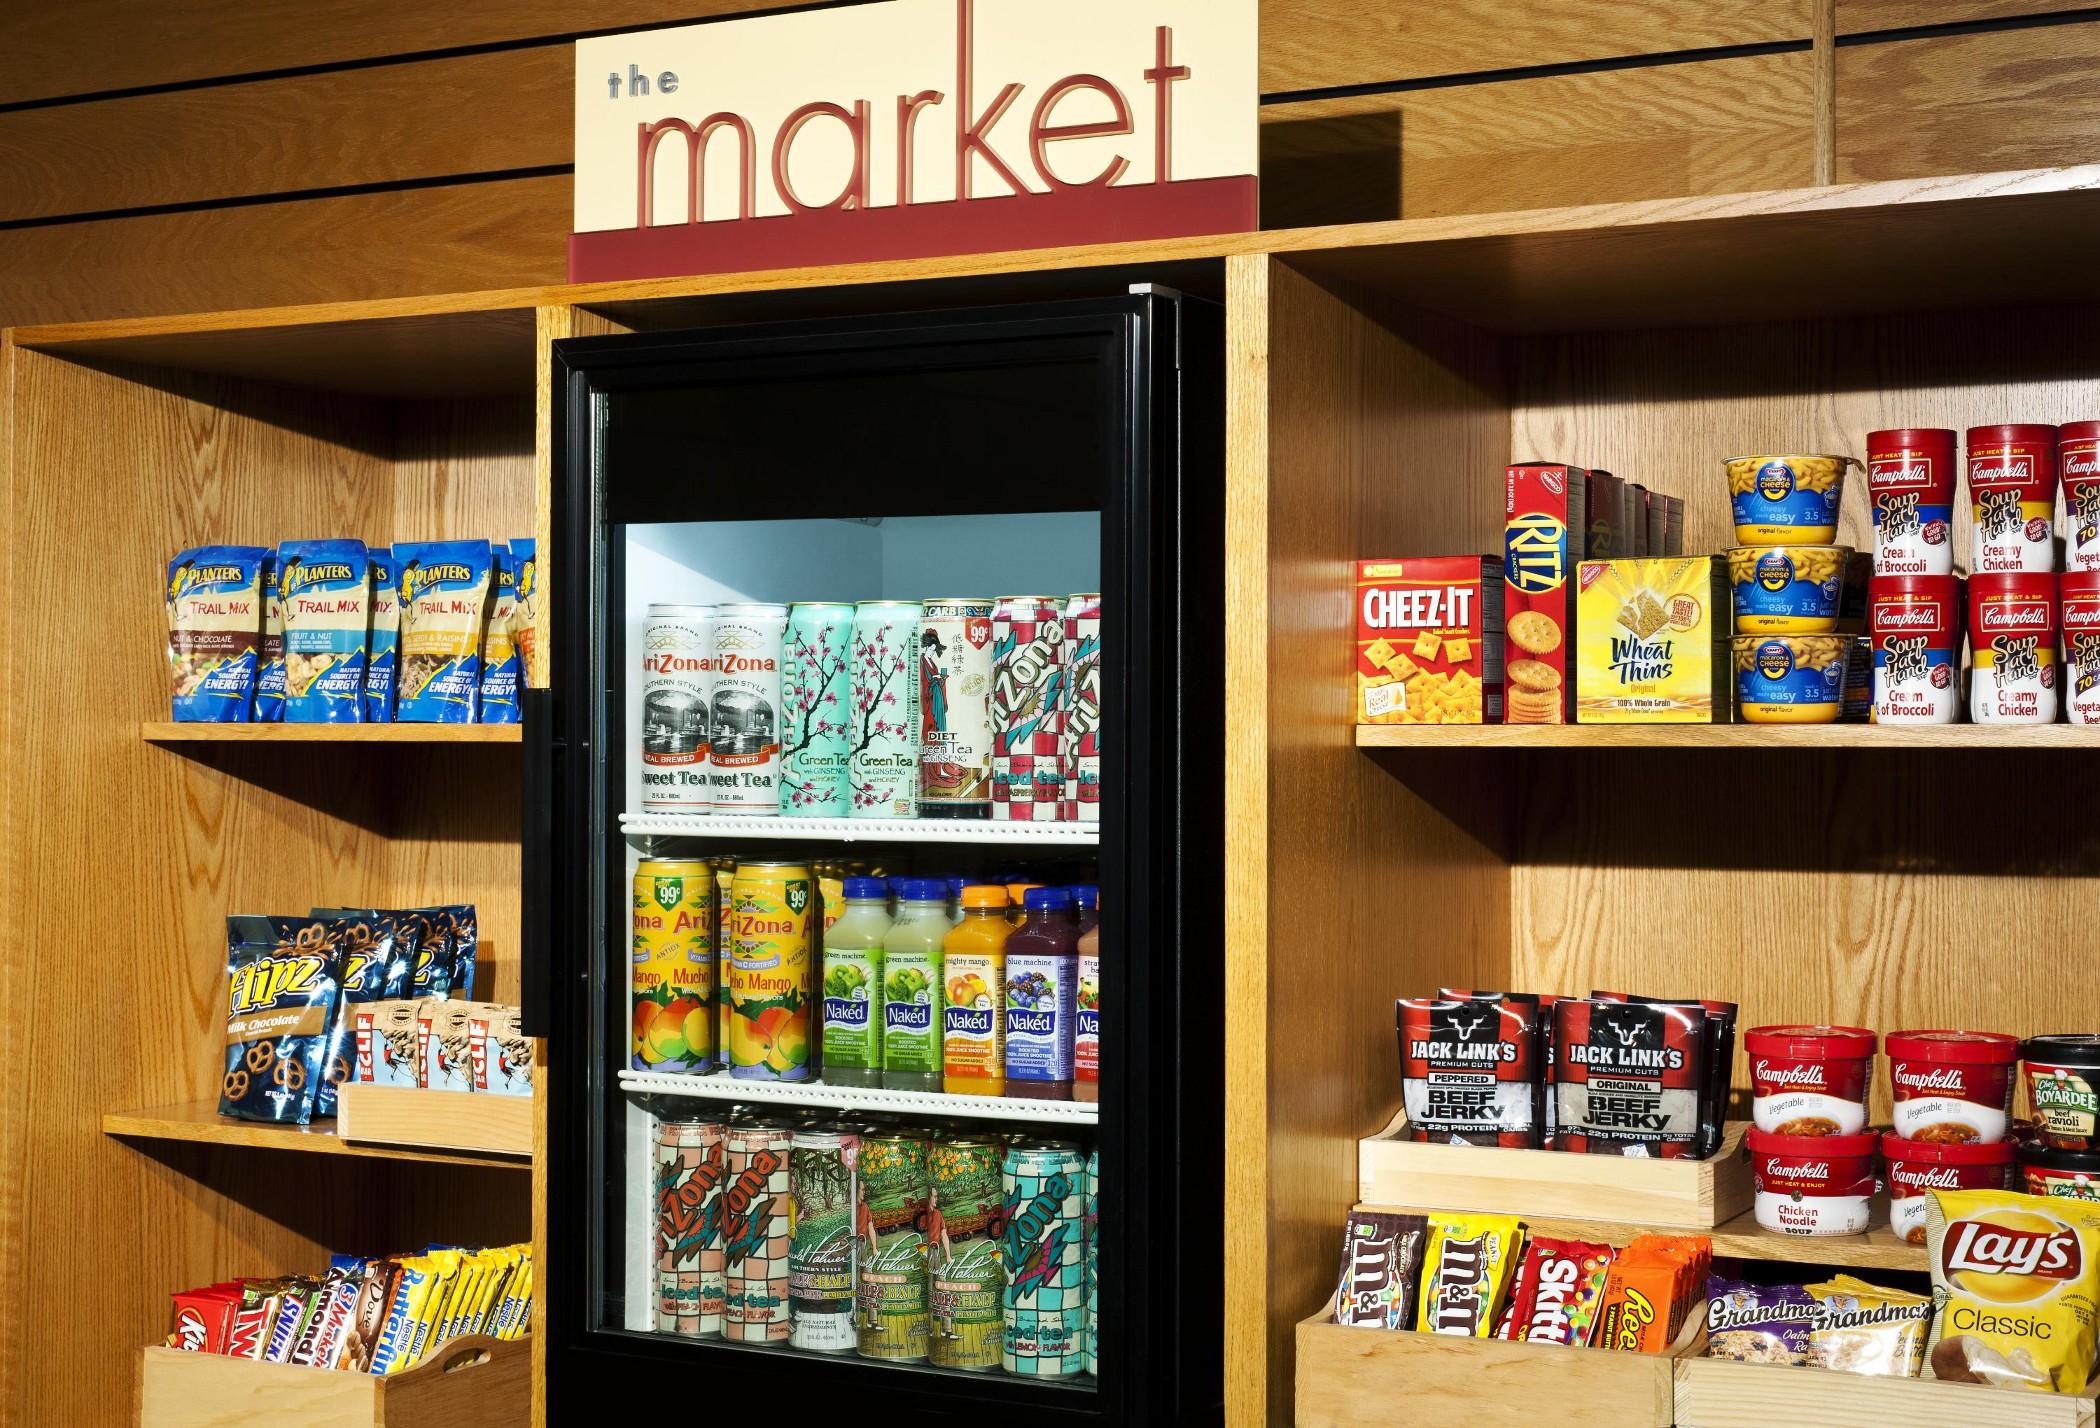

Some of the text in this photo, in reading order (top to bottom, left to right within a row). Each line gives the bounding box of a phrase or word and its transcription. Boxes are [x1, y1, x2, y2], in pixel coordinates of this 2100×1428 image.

[607, 64, 679, 99] the
[637, 0, 1191, 229] market
[1877, 491, 1920, 521] Soup
[1978, 489, 2022, 518] Soup
[1769, 513, 1796, 524] easy
[1804, 511, 1819, 521] 3.5
[1891, 508, 1909, 526] at
[1993, 505, 2009, 521] at
[1878, 511, 1920, 546] Hand
[1980, 507, 2024, 543] Hand
[2080, 526, 2096, 542] 70
[1507, 519, 1563, 589] RITZ
[1885, 560, 1927, 573] Broccoli
[1983, 558, 2023, 571] Chicken
[188, 566, 242, 585] PLANTERS
[295, 565, 352, 584] PLANTERS
[414, 566, 471, 584] PLANTERS
[190, 601, 250, 615] TRAIL MIX
[298, 600, 360, 614] TRAIL MIX
[420, 601, 477, 615] TRAIL MIX
[928, 605, 957, 617] CARB
[1363, 586, 1474, 628] CHEEZ-IT
[1673, 599, 1695, 610] GREAT
[1768, 602, 1794, 615] easy
[1801, 601, 1816, 612] 3.5
[1758, 617, 1776, 626] original
[193, 635, 233, 643] CHOCOLATE
[317, 632, 333, 640] NUT
[1610, 633, 1676, 664] Wheat
[1882, 635, 1929, 664] Soup
[1991, 634, 2039, 664] Soup
[1899, 650, 1916, 669] at
[2010, 650, 2026, 669] at
[1608, 660, 1673, 685] Thins
[1884, 654, 1929, 688] Hand
[1993, 654, 2038, 688] Hand
[204, 678, 249, 690] ENERGY!
[1630, 683, 1656, 694] Original
[2078, 675, 2093, 691] 70
[1770, 690, 1797, 703] easy
[1805, 688, 1820, 698] 3.5
[1617, 699, 1671, 707] 100% Whole Grain
[1881, 703, 1935, 717] of Broccoli
[1997, 703, 2038, 716] Chicken
[928, 732, 958, 741] DIET
[946, 741, 973, 754] Tea
[661, 754, 695, 764] BREWED
[724, 755, 759, 766] BREWED
[799, 752, 835, 767] Green
[860, 752, 913, 767] Green Tea
[677, 770, 708, 786] Tea
[813, 767, 846, 776] GINSENG
[872, 767, 906, 776] GINSENG
[994, 769, 1032, 786] Iced
[740, 772, 772, 788] Tea
[655, 942, 681, 961] ANTIOX
[946, 957, 968, 966] mighty
[1008, 957, 1022, 966] blue
[673, 968, 709, 984] Mucho
[749, 973, 792, 994] Mango
[229, 958, 321, 1012] Flipz
[826, 1003, 863, 1020] Naked
[889, 1007, 926, 1024] Naked
[227, 1021, 247, 1034] Milk
[248, 1014, 301, 1031] Chocolate
[947, 1013, 988, 1029] Naked
[1008, 1013, 1051, 1031] Naked
[357, 1016, 373, 1067] CLIF
[471, 1023, 488, 1074] CLIF
[1411, 1041, 1516, 1063] JACK LINK'S
[1570, 1044, 1683, 1069] JACK LINK'S
[1430, 1060, 1469, 1068] PREMIUM
[1590, 1066, 1659, 1076] PREMIUM CUTS
[1434, 1074, 1489, 1084] PEPPERED
[1596, 1079, 1652, 1092] ORIGINAL
[2038, 1079, 2056, 1091] Chef
[1428, 1090, 1496, 1105] BEEF
[1587, 1095, 1661, 1114] BEEF
[2035, 1088, 2099, 1112] BOYARDEE
[1420, 1105, 1506, 1120] JERKY
[1768, 1097, 1805, 1115] Vegetable
[1906, 1101, 1943, 1119] Vegetable
[2054, 1107, 2071, 1118] beef
[1427, 1123, 1498, 1132] 22g PROTEIN
[1582, 1111, 1672, 1132] JERKY
[2047, 1115, 2080, 1127] ravioli
[1587, 1129, 1661, 1141] 22g PROTEIN
[2053, 1184, 2072, 1196] Chef
[1778, 1204, 1819, 1217] Chicken
[1779, 1214, 1818, 1227] Noodle
[1785, 1227, 1813, 1235] SOUP
[1489, 1236, 1499, 1264] PEANUT
[1948, 1222, 2074, 1275] Lay's
[340, 1286, 356, 1306] 3
[661, 1284, 699, 1300] Iced
[361, 1279, 384, 1329] Dove
[748, 1294, 781, 1308] tea
[1607, 1310, 1616, 1332] PEANUT
[1953, 1308, 2052, 1340] Classic
[228, 1299, 271, 1360] TW
[1039, 1324, 1073, 1342] tea
